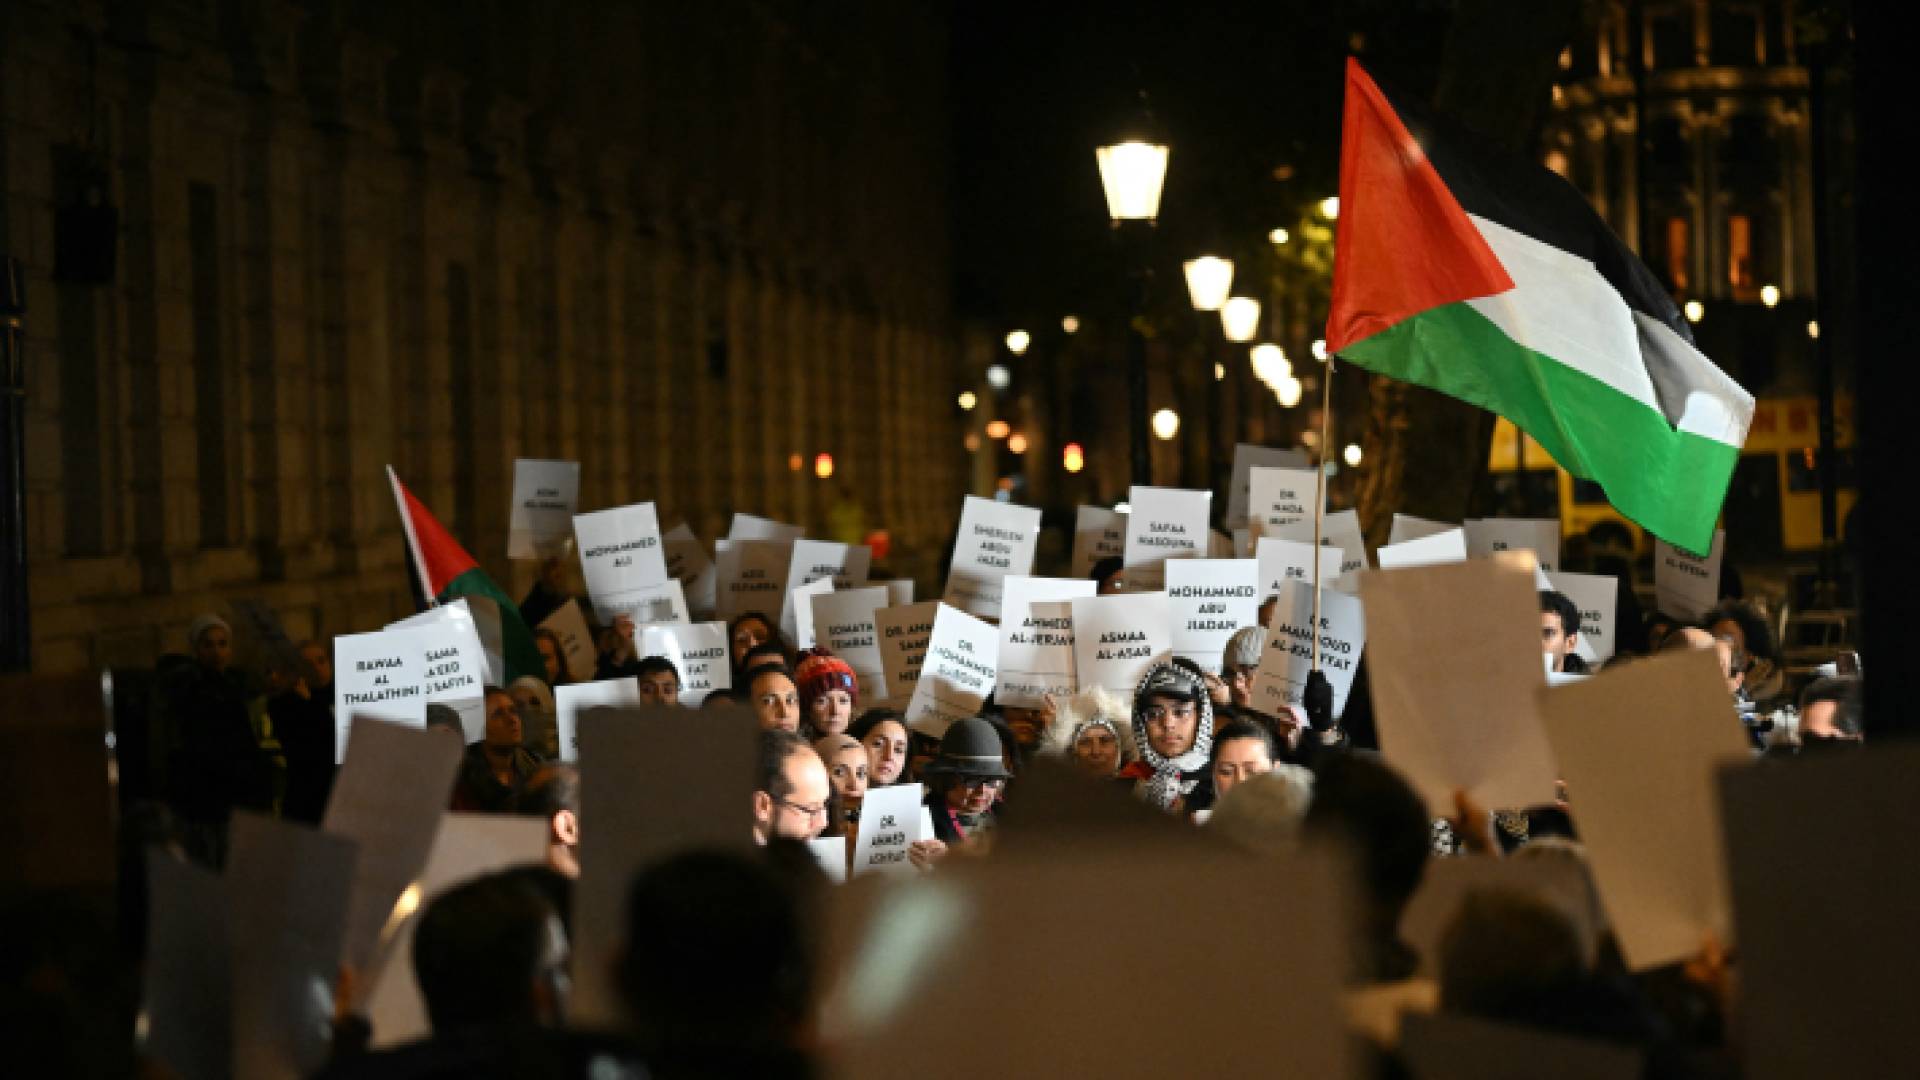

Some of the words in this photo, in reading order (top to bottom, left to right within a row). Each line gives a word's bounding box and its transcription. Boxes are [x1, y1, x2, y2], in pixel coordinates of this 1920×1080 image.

[585, 537, 657, 558] MOHAMMED
[1168, 586, 1255, 598] MOHAMMED
[1198, 604, 1226, 614] ABU
[1098, 631, 1147, 643] ASMAA
[958, 639, 975, 652] DR.
[1096, 646, 1152, 660] AL-ASAR
[932, 646, 994, 678] MOHAMMED
[879, 814, 897, 829] DR.
